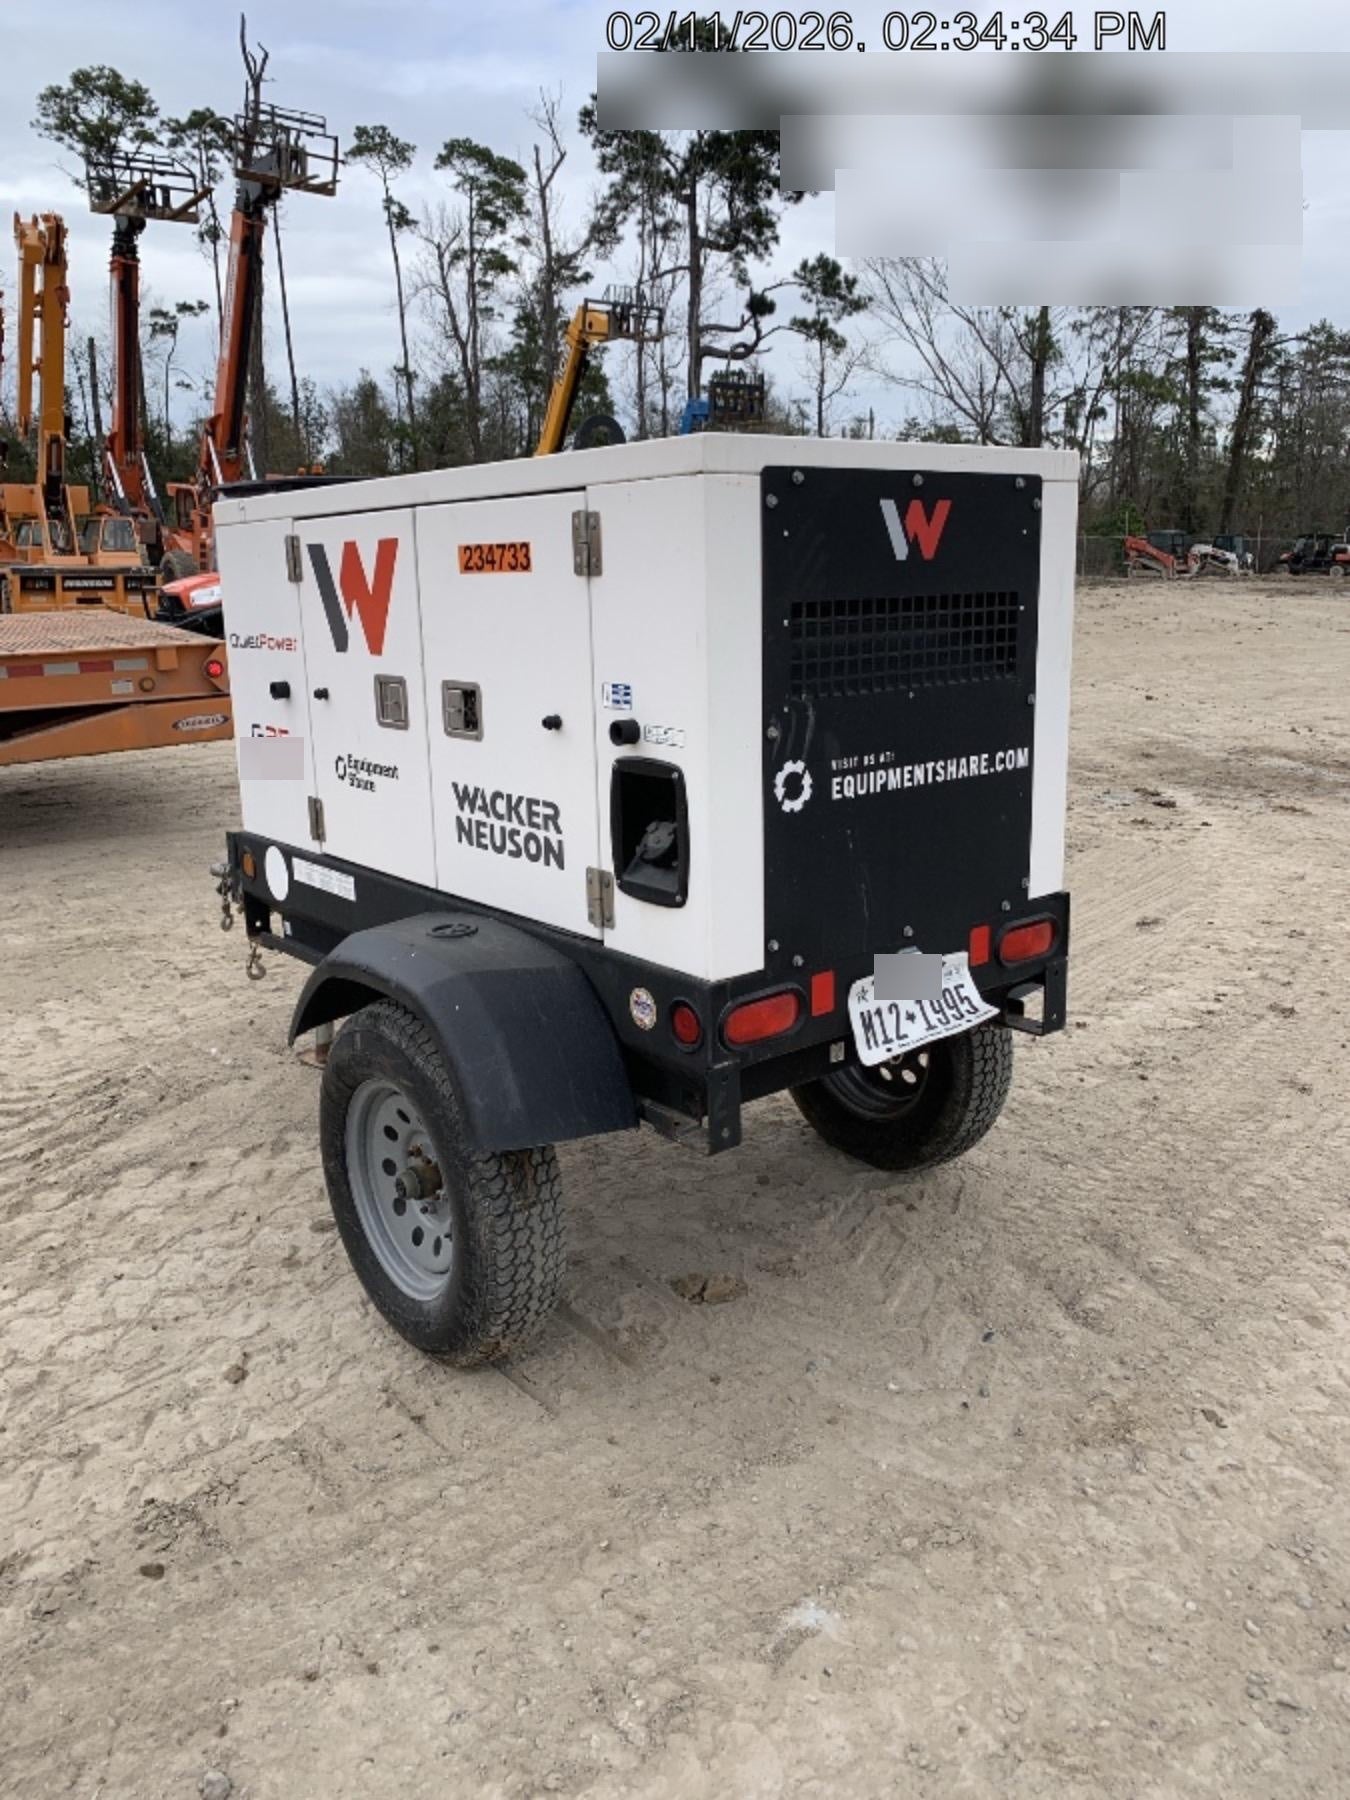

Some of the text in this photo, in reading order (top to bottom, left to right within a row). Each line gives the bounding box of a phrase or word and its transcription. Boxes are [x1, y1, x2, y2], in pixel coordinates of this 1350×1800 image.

[462, 542, 532, 571] 234733
[347, 753, 399, 780] Equipment
[831, 747, 1030, 801] EQUIPMENTSHARE.COM
[451, 781, 563, 835] WACKER
[455, 815, 565, 871] NEUSON
